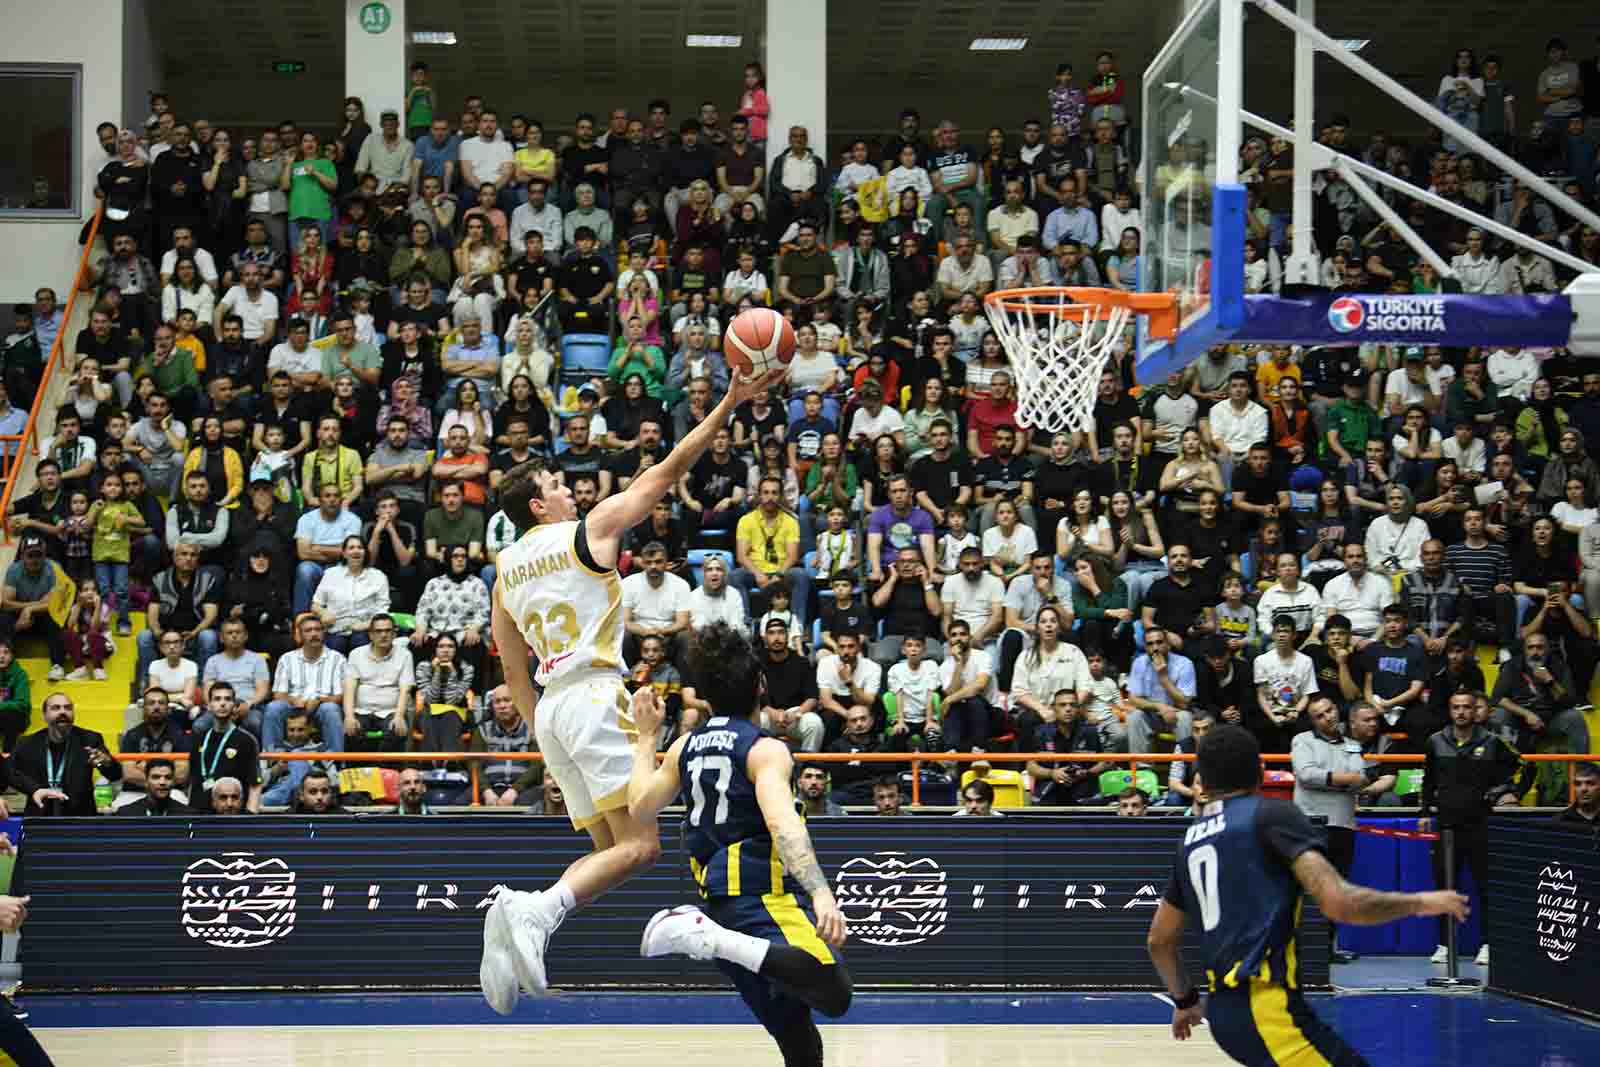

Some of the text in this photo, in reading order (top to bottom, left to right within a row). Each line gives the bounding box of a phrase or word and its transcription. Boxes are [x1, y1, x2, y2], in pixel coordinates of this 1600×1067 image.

[364, 8, 385, 25] A1
[502, 552, 572, 591] KARAHAN
[1188, 845, 1220, 931] 0
